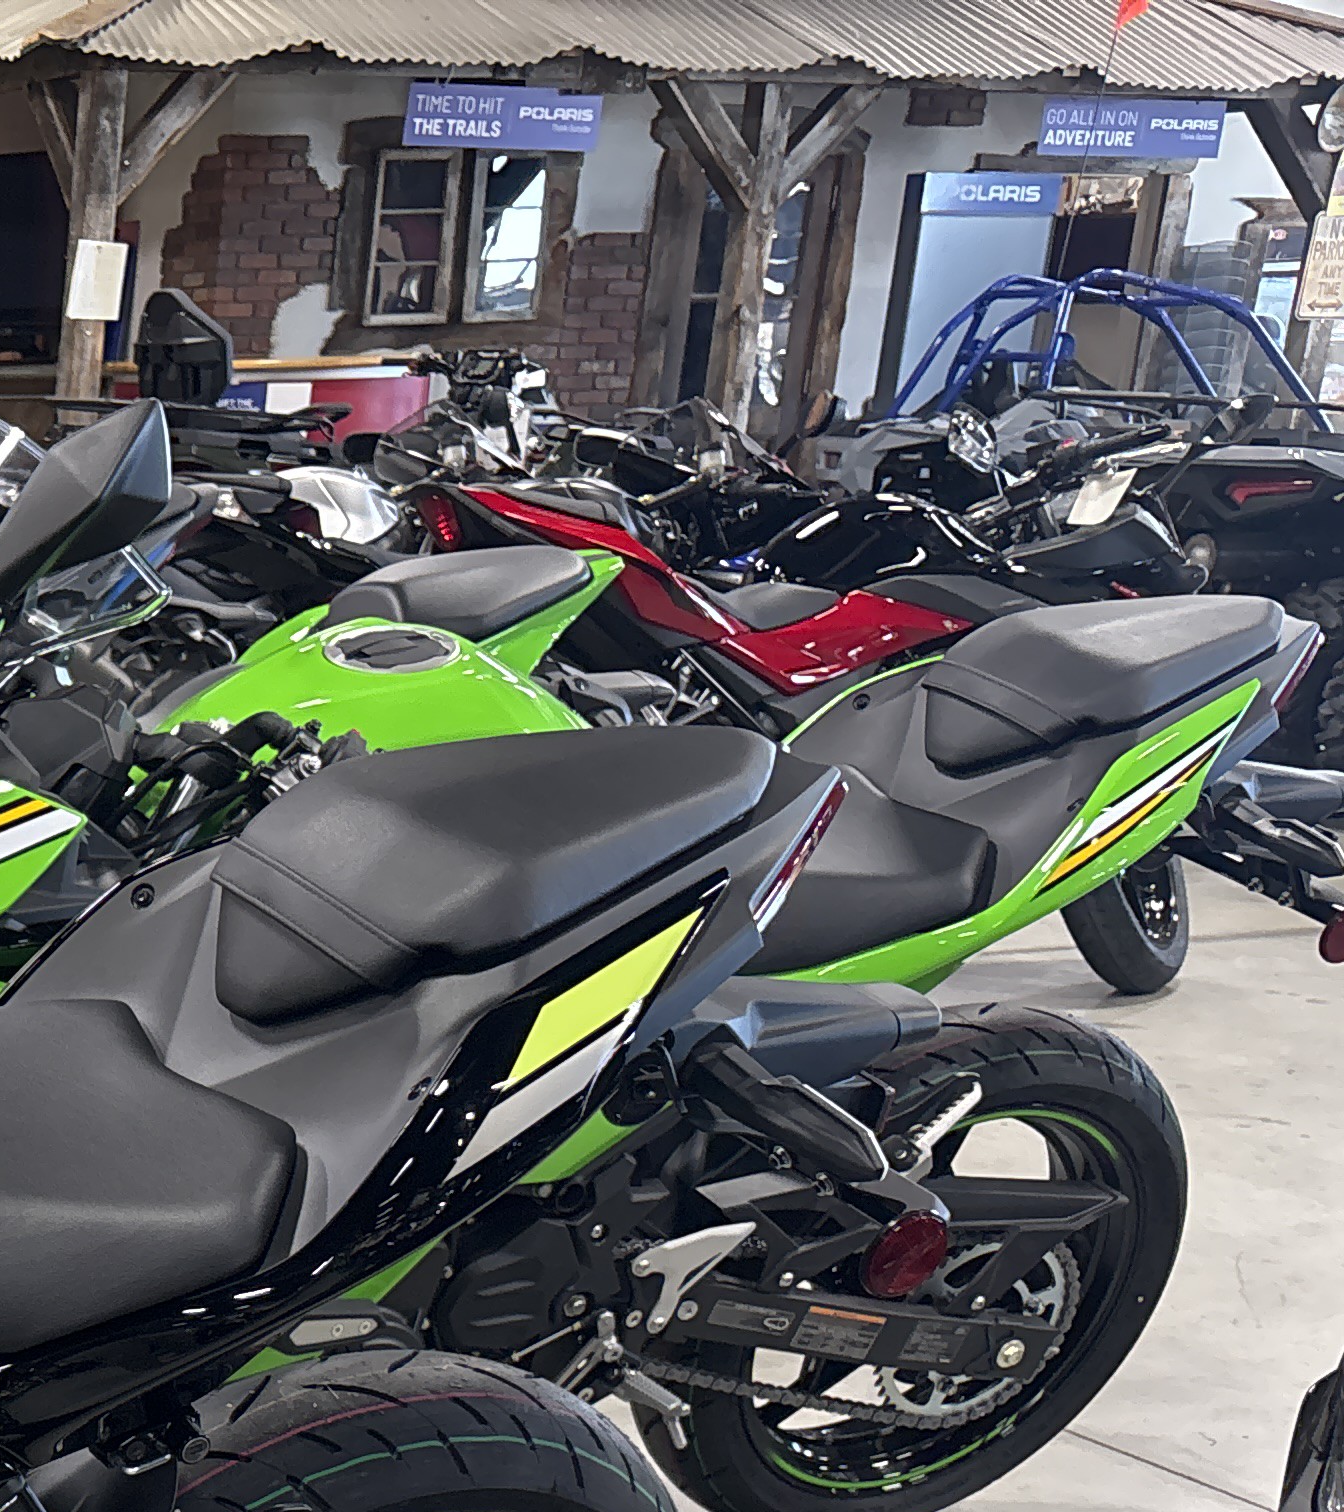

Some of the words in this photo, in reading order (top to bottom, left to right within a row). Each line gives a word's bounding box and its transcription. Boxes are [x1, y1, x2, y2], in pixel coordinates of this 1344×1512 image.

[416, 94, 453, 114] TIME
[457, 95, 476, 115] TO
[478, 96, 505, 116] HIT
[518, 106, 594, 122] POLARIS
[1046, 108, 1066, 126] GO
[1069, 108, 1094, 127] ALL
[1100, 110, 1117, 127] IN
[1119, 110, 1139, 127] ON
[1150, 117, 1219, 131] POLARIS
[413, 117, 444, 136] THE
[446, 119, 502, 138] TRAILS
[1043, 129, 1135, 147] ADVENTURE
[959, 184, 1041, 202] OLARIS
[1321, 264, 1344, 279] ANY
[1317, 281, 1342, 298] TIME
